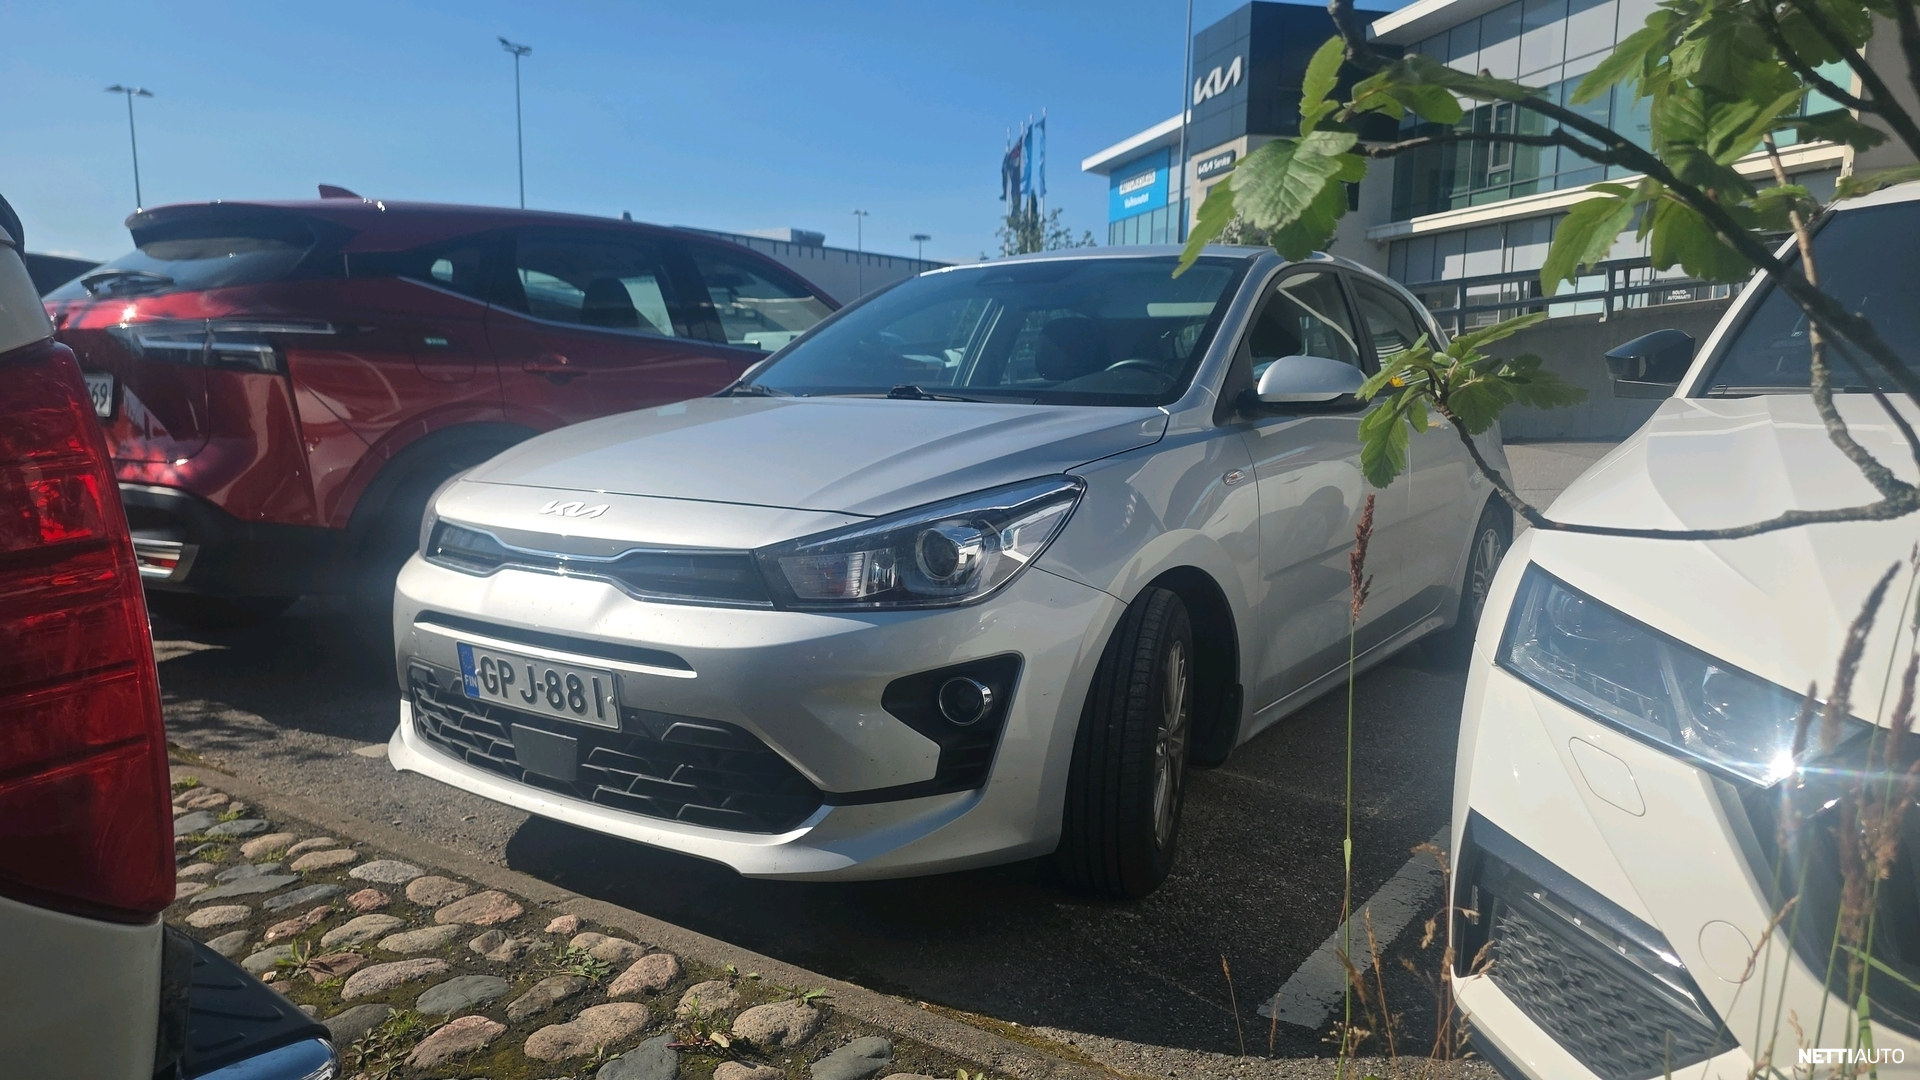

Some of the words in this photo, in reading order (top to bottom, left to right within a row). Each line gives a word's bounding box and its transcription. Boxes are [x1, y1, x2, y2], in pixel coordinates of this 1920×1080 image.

[1193, 55, 1243, 106] KIA
[87, 382, 108, 408] 69
[538, 500, 611, 519] KIA
[464, 674, 478, 688] FIN
[479, 656, 605, 720] GPJ-881
